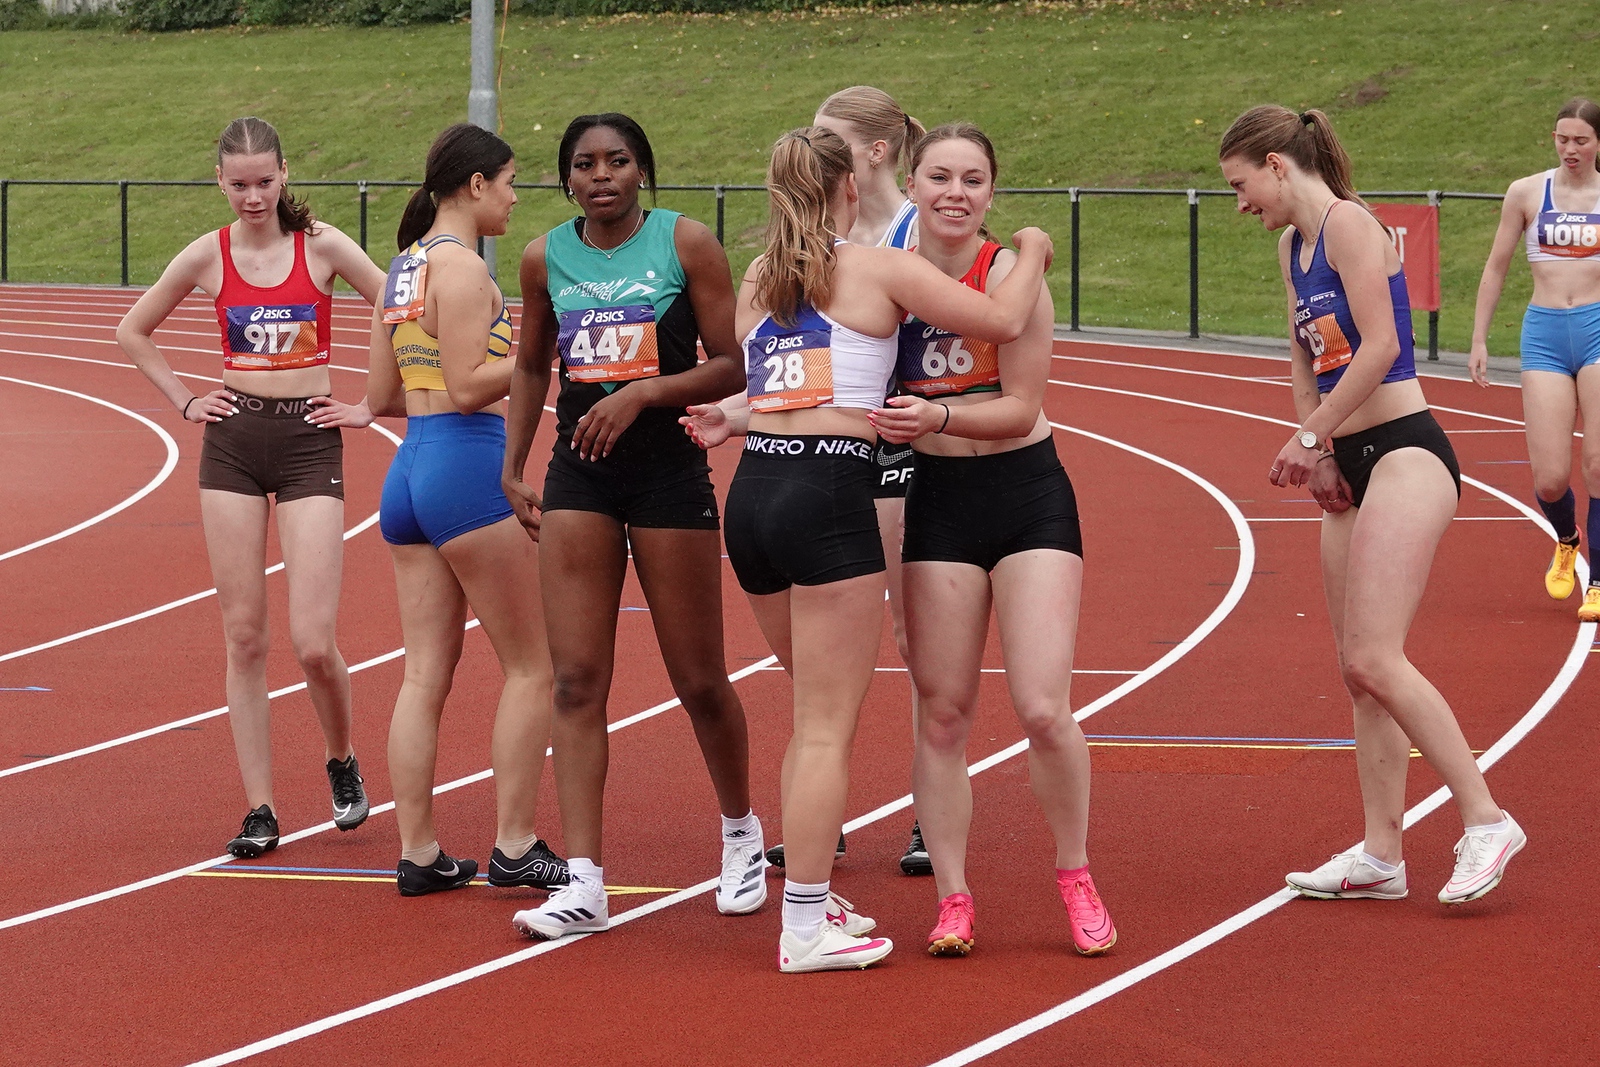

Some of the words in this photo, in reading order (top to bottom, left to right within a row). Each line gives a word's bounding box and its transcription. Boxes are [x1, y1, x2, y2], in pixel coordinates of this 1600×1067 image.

[1565, 215, 1587, 223] asics
[1544, 224, 1598, 247] 1018
[558, 276, 628, 298] ROTTERDAM
[263, 309, 292, 319] asics
[594, 310, 626, 323] asics
[244, 323, 301, 354] 917
[569, 325, 644, 364] 447
[778, 335, 804, 350] asics
[1299, 323, 1325, 357] 25
[921, 338, 974, 377] 66
[763, 352, 806, 392] 28
[274, 400, 320, 415] NIK
[814, 439, 873, 460] NIKE
